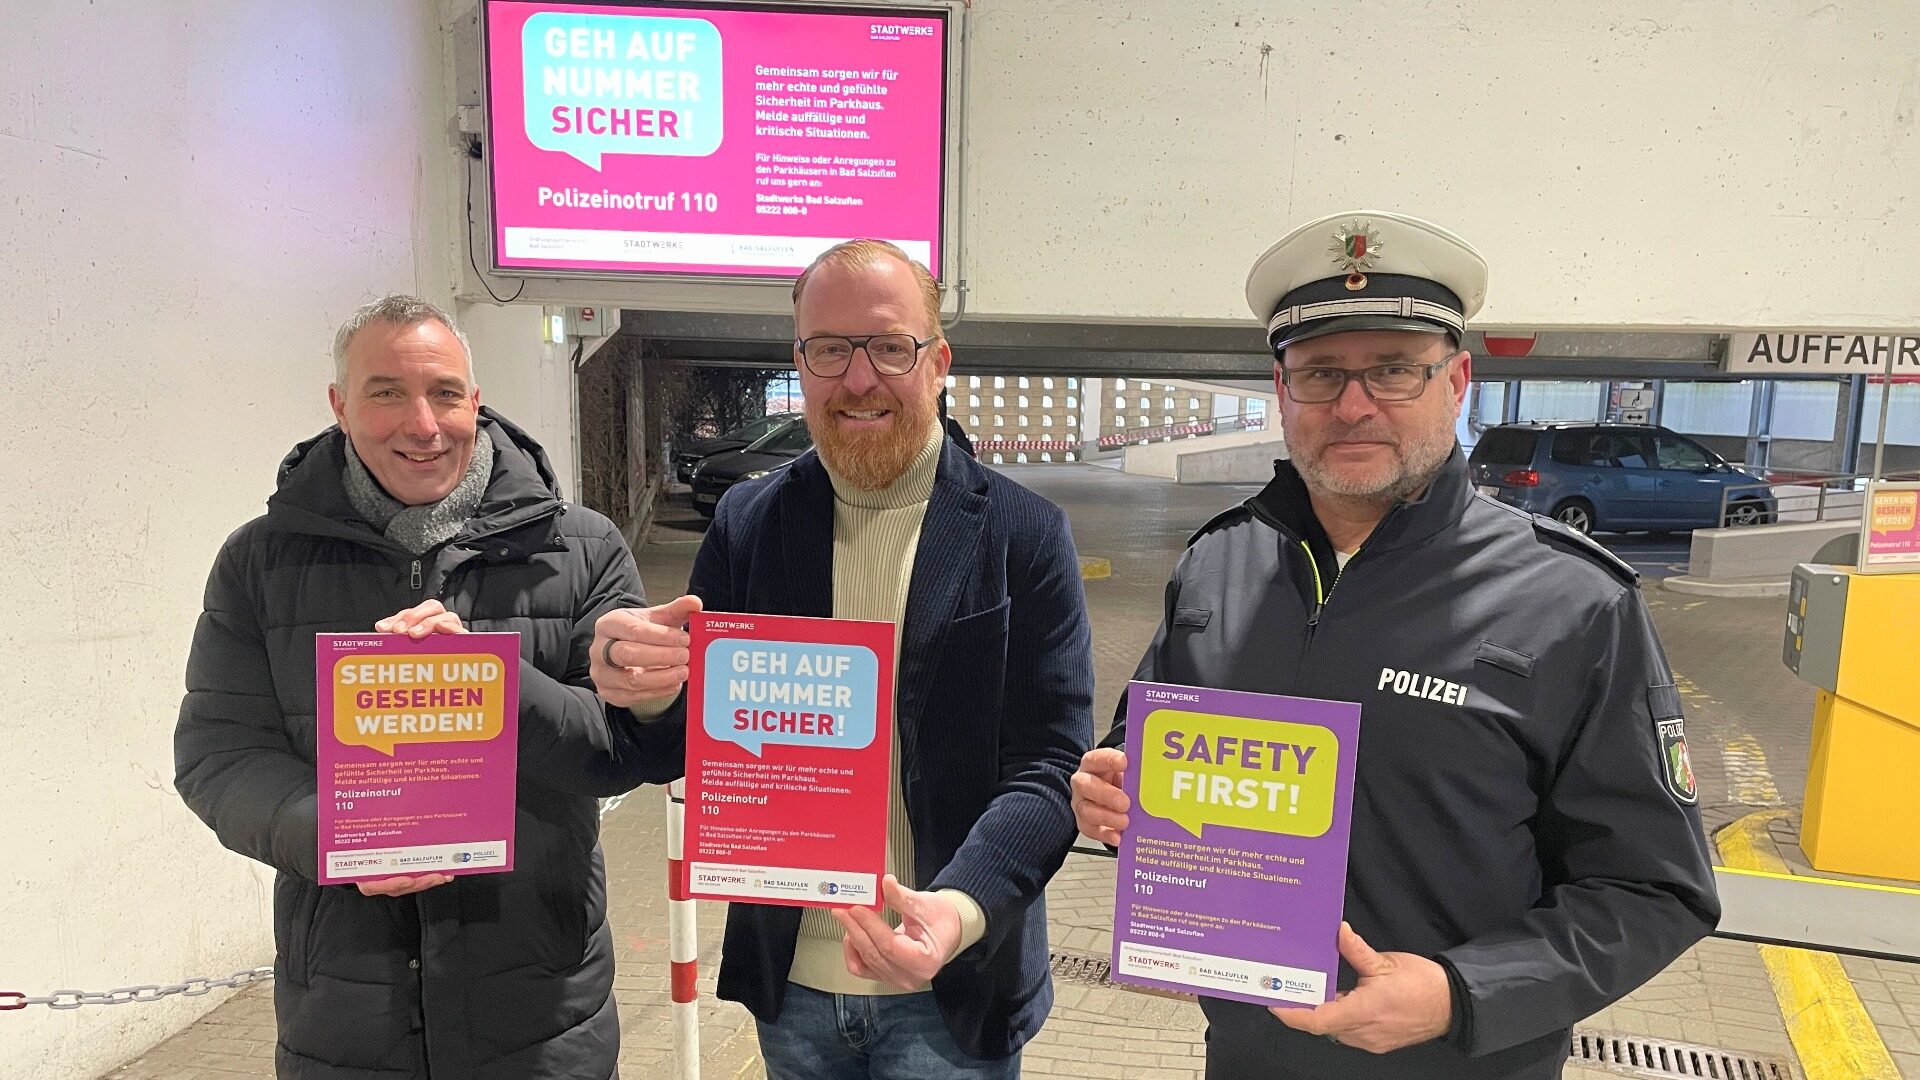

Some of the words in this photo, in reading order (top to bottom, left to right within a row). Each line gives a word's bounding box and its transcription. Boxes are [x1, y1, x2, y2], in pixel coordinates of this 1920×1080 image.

[870, 25, 934, 36] STADTWERKE
[544, 27, 614, 59] GEH
[624, 30, 697, 62] AUF
[755, 65, 819, 77] Gemeinsam
[822, 70, 859, 81] sorgen
[862, 69, 878, 79] wir
[882, 70, 899, 80] für
[543, 67, 700, 102] NUMMER
[755, 80, 783, 91] mehr
[787, 81, 816, 92] echte
[820, 82, 839, 93] und
[843, 83, 888, 97] gefühlte
[755, 95, 810, 108] Sicherheit
[814, 97, 827, 109] im
[830, 98, 884, 111] Parkhaus.
[551, 105, 692, 140] SICHER!
[755, 110, 788, 121] Melde
[792, 111, 842, 125] auffällige
[845, 113, 866, 123] und
[755, 125, 803, 138] kritische
[806, 126, 870, 140] Situationen.
[755, 153, 769, 162] Für
[772, 154, 810, 163] Hinweise
[812, 155, 830, 164] oder
[834, 156, 884, 168] Anregungen
[755, 165, 771, 175] den
[773, 165, 827, 177] Parkhäusern
[830, 167, 837, 177] in
[839, 167, 855, 178] Bad
[858, 168, 897, 179] Salzuflen
[537, 187, 674, 211] Polizeinotruf
[682, 192, 718, 213] 110
[705, 621, 754, 630] STADTWERKE
[732, 650, 787, 675] GEH
[796, 654, 851, 678] AUF
[340, 663, 433, 684] SEHEN
[443, 662, 498, 683] UND
[1377, 667, 1468, 705] POLIZEI
[356, 687, 483, 709] GESEHEN
[729, 680, 852, 708] NUMMER
[1146, 690, 1199, 702] STADTWERKE
[354, 712, 483, 735] WERDEN!
[733, 708, 845, 736] SICHER!
[1162, 729, 1317, 776] SAFETY
[702, 760, 744, 768] Gemeinsam
[798, 765, 816, 773] mehr
[702, 769, 731, 778] gefühlte
[733, 771, 769, 779] Sicherheit
[782, 773, 817, 782] Parkhaus.
[335, 787, 401, 799] Polizeinotruf
[725, 780, 758, 789] auffällige
[776, 783, 806, 791] kritische
[1171, 770, 1300, 814] FIRST!
[335, 802, 354, 810] 110
[701, 792, 768, 805] Polizeinotruf
[701, 805, 719, 815] 110
[1135, 846, 1167, 858] gefühlte
[1170, 850, 1209, 861] Sicherheit
[1211, 855, 1221, 863] im
[1136, 836, 1181, 848] Gemeinsam
[1184, 844, 1210, 853] sorgen
[1213, 846, 1225, 854] wir
[1228, 848, 1240, 856] für
[1242, 849, 1263, 859] mehr
[1265, 852, 1287, 862] echte
[1289, 856, 1305, 864] und
[335, 859, 382, 868] STADTWERKE
[1135, 855, 1158, 864] Melde
[1161, 859, 1197, 871] auffällige
[1200, 864, 1214, 872] und
[1216, 866, 1250, 877] kritische
[698, 875, 746, 884] STADTWERKE
[777, 880, 809, 888] SALZUFLEN
[1134, 869, 1207, 888] Polizeinotruf
[1133, 883, 1153, 895] 110
[1128, 956, 1180, 969] STADTWERKE
[1214, 970, 1248, 980] SALZUFLEN
